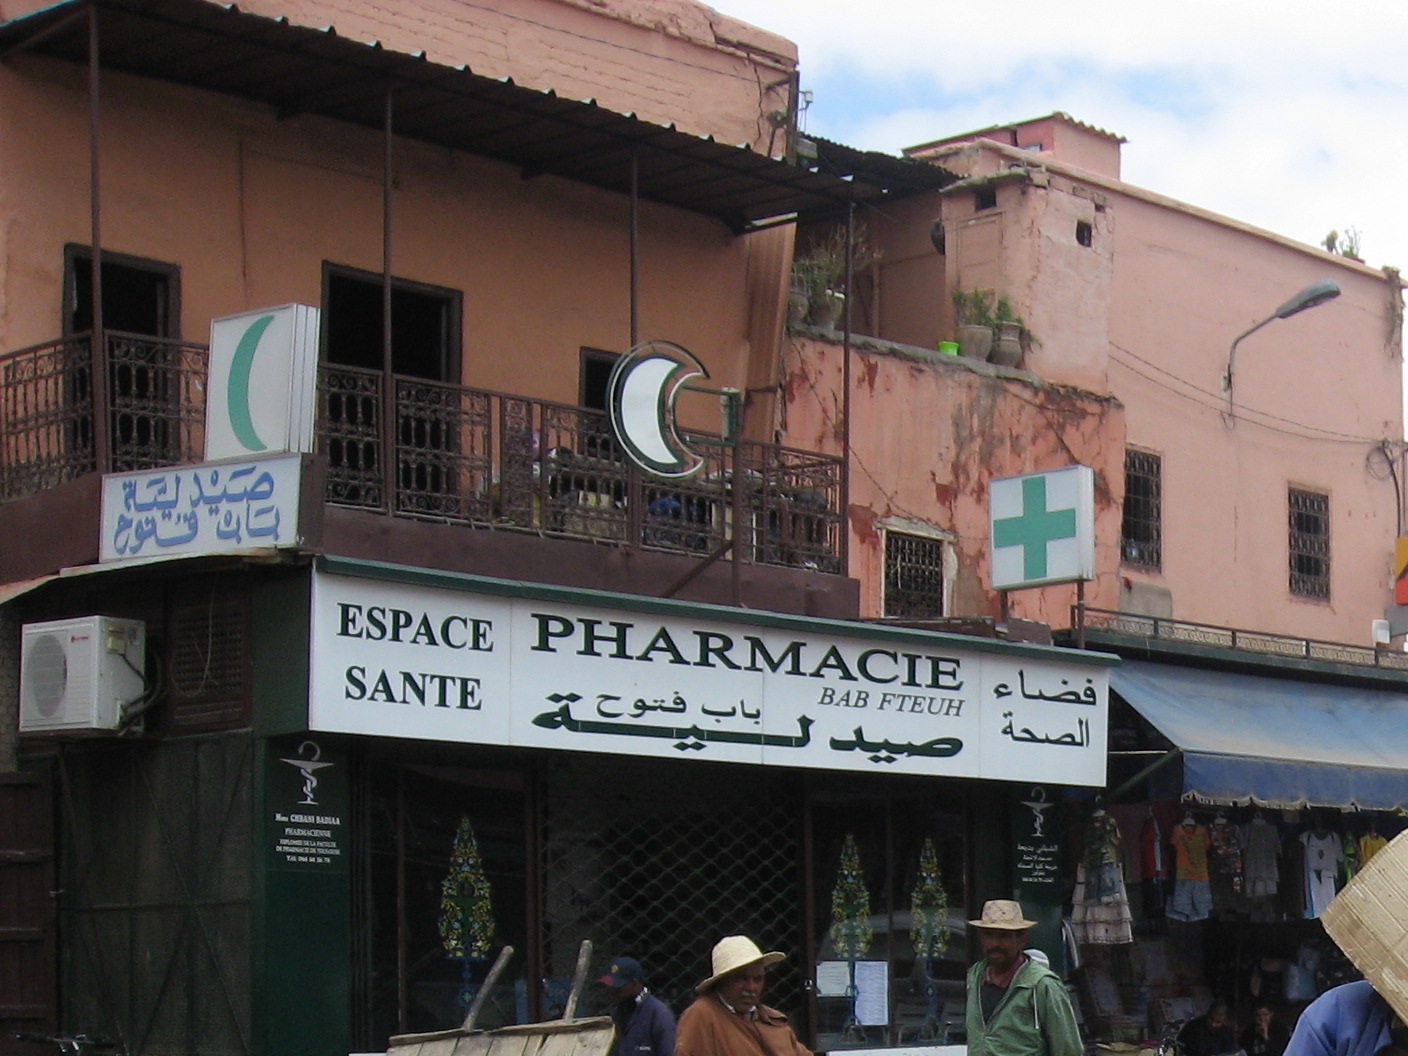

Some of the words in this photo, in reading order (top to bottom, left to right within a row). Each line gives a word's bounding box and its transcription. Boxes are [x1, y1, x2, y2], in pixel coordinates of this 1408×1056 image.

[336, 602, 495, 653] ESPACE
[530, 612, 964, 692] PHARMACIE
[344, 665, 483, 711] SANTE
[596, 690, 688, 718] فتوح
[818, 686, 870, 709] BAB
[876, 691, 966, 718] FTEUH
[991, 668, 1098, 706] فضاء
[700, 699, 762, 725] باب
[1000, 710, 1091, 748] الصحة
